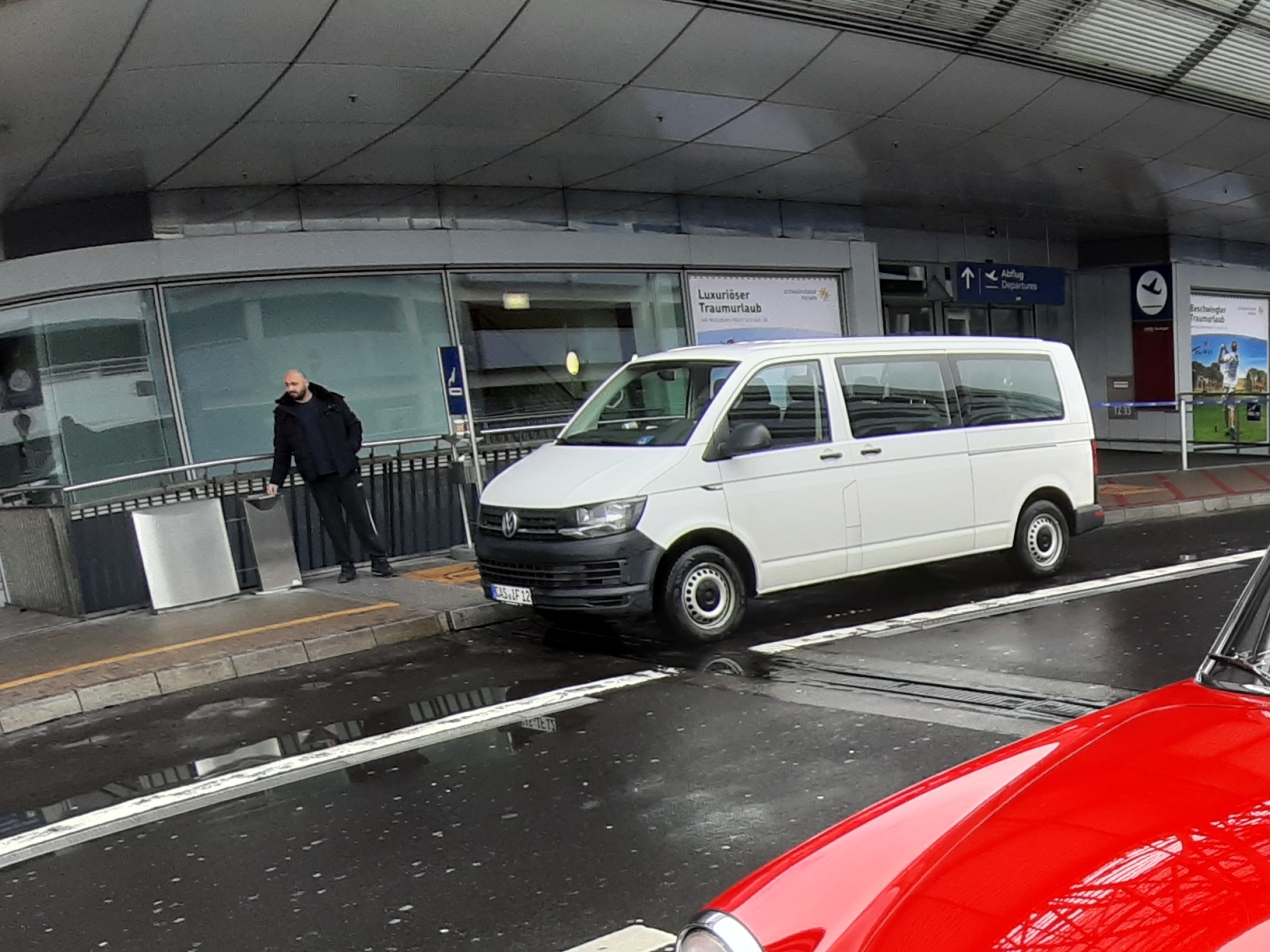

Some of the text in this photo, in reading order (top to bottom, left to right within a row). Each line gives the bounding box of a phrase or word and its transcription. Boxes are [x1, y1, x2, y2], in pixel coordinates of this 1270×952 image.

[1001, 269, 1025, 281] Abflug
[1001, 280, 1038, 291] Departures
[698, 288, 751, 300] Luxuriöser
[698, 302, 762, 314] Traumurlaub
